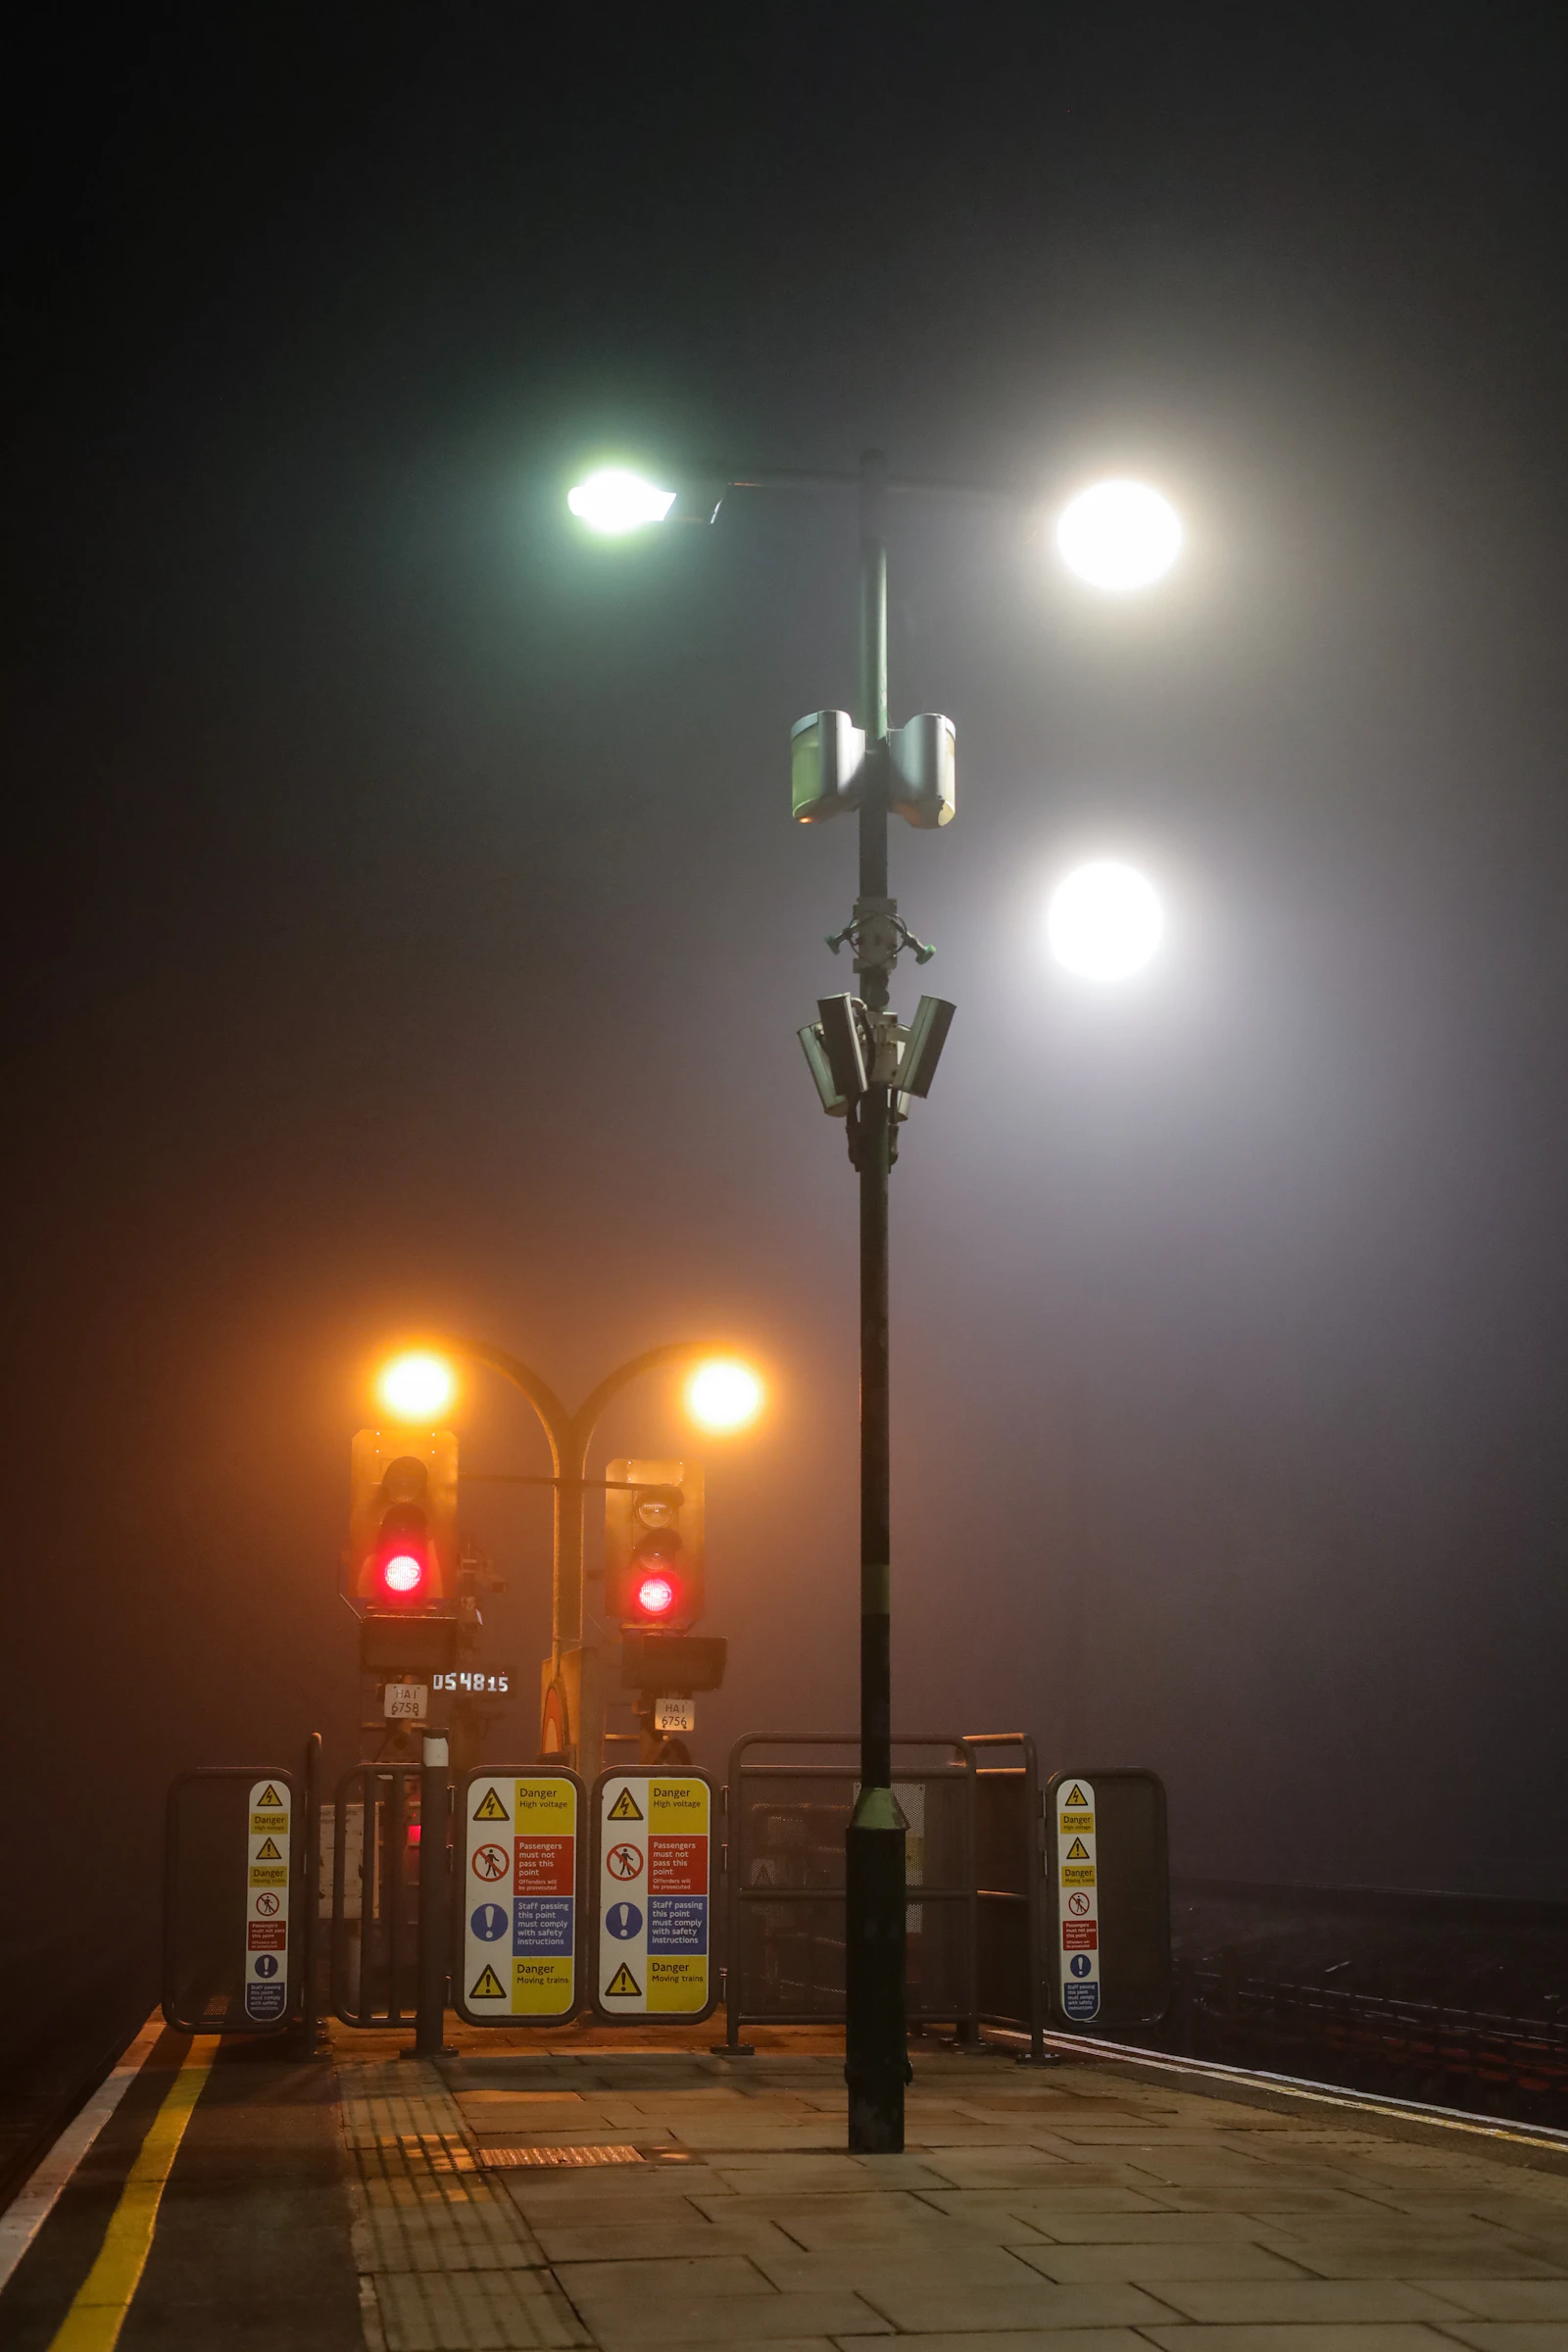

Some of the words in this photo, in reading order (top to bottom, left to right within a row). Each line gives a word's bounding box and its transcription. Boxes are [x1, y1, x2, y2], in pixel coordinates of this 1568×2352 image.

[391, 1702, 419, 1713] 6758
[662, 1716, 687, 1727] 6756
[519, 1788, 558, 1799] Danger
[653, 1788, 691, 1799] Danger
[519, 1800, 537, 1809] High
[539, 1800, 568, 1809] voltage
[653, 1800, 671, 1809] High
[672, 1800, 702, 1809] voltage
[254, 1816, 285, 1825] Danger
[1063, 1815, 1091, 1825] Danger
[519, 1842, 563, 1851] Passengers
[653, 1841, 697, 1851] Passengers
[253, 1869, 284, 1878] Danger
[653, 1868, 673, 1877] point
[1064, 1869, 1093, 1878] Danger
[540, 1902, 569, 1911] passing
[674, 1901, 704, 1910] passing
[535, 1911, 557, 1920] point
[669, 1910, 691, 1919] point
[539, 1920, 568, 1929] comply
[674, 1919, 703, 1928] comply
[537, 1929, 564, 1937] safety
[671, 1928, 698, 1936] safety
[516, 1964, 555, 1976] Danger
[652, 1962, 690, 1974] Danger
[516, 1977, 545, 1985] Moving
[652, 1975, 679, 1984] Moving
